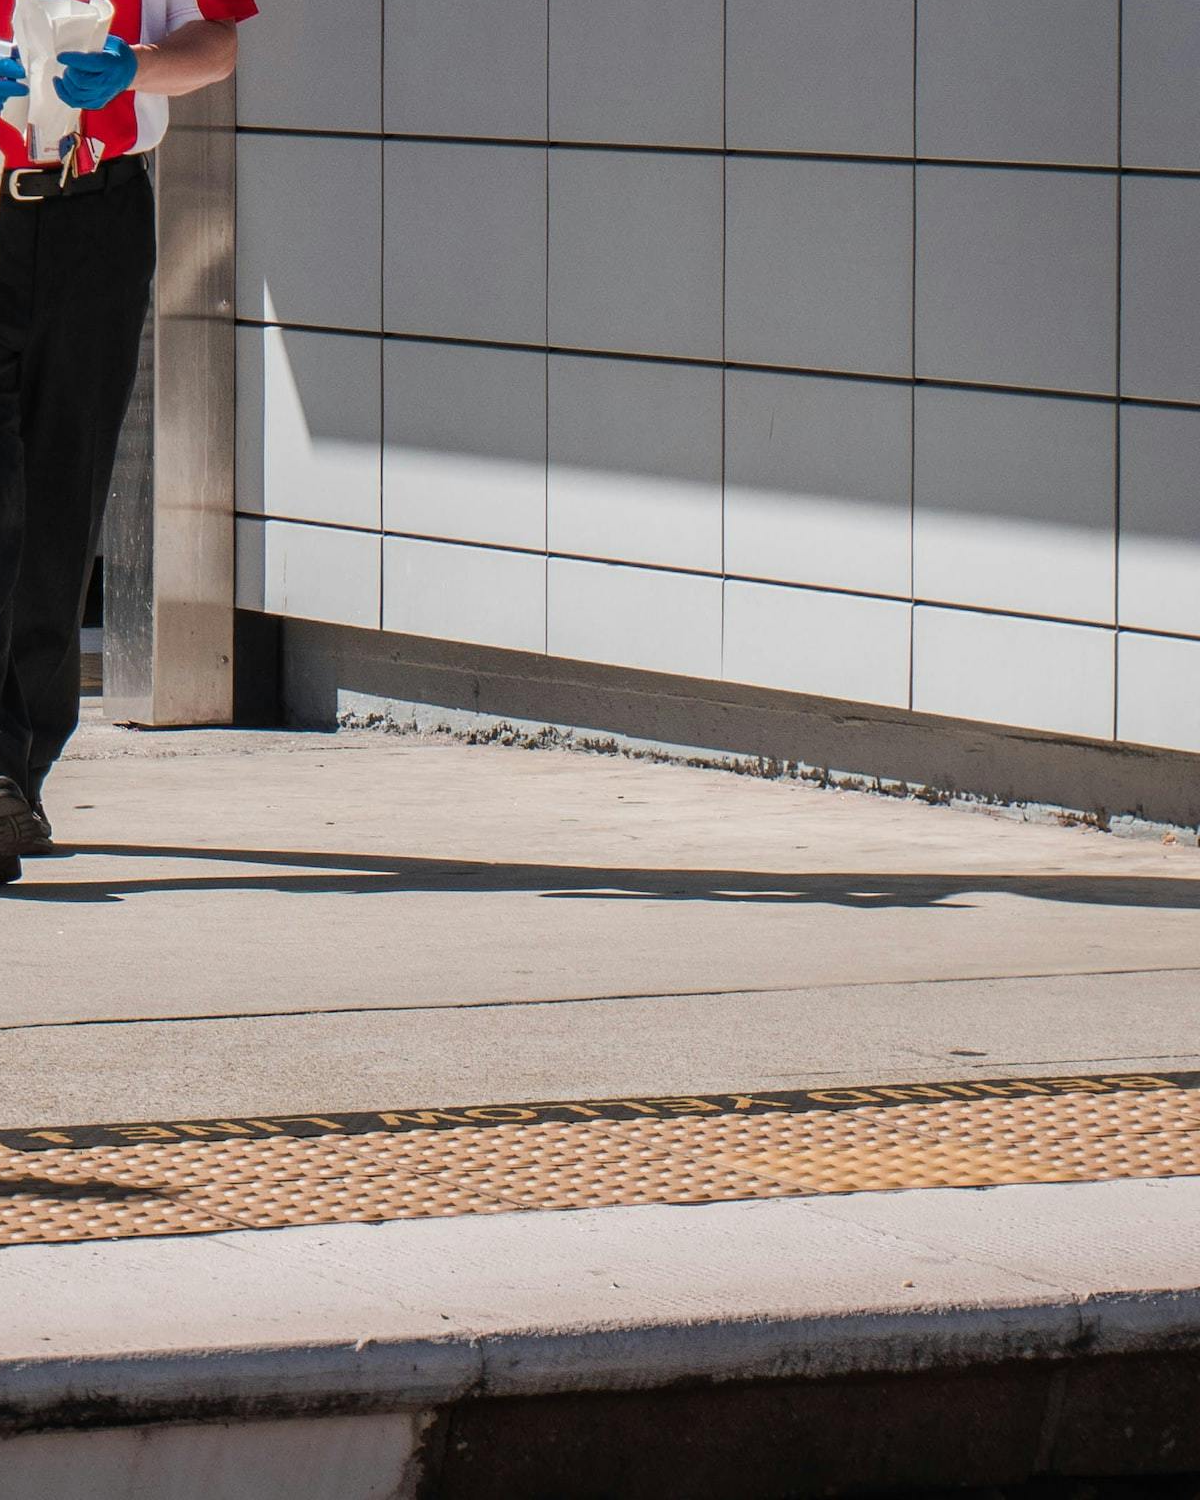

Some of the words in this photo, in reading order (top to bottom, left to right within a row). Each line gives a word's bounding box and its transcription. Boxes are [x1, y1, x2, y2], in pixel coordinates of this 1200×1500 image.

[807, 1075, 1179, 1103] BEHIND
[378, 1095, 791, 1126] YELLOW
[104, 1118, 345, 1139] LINE
